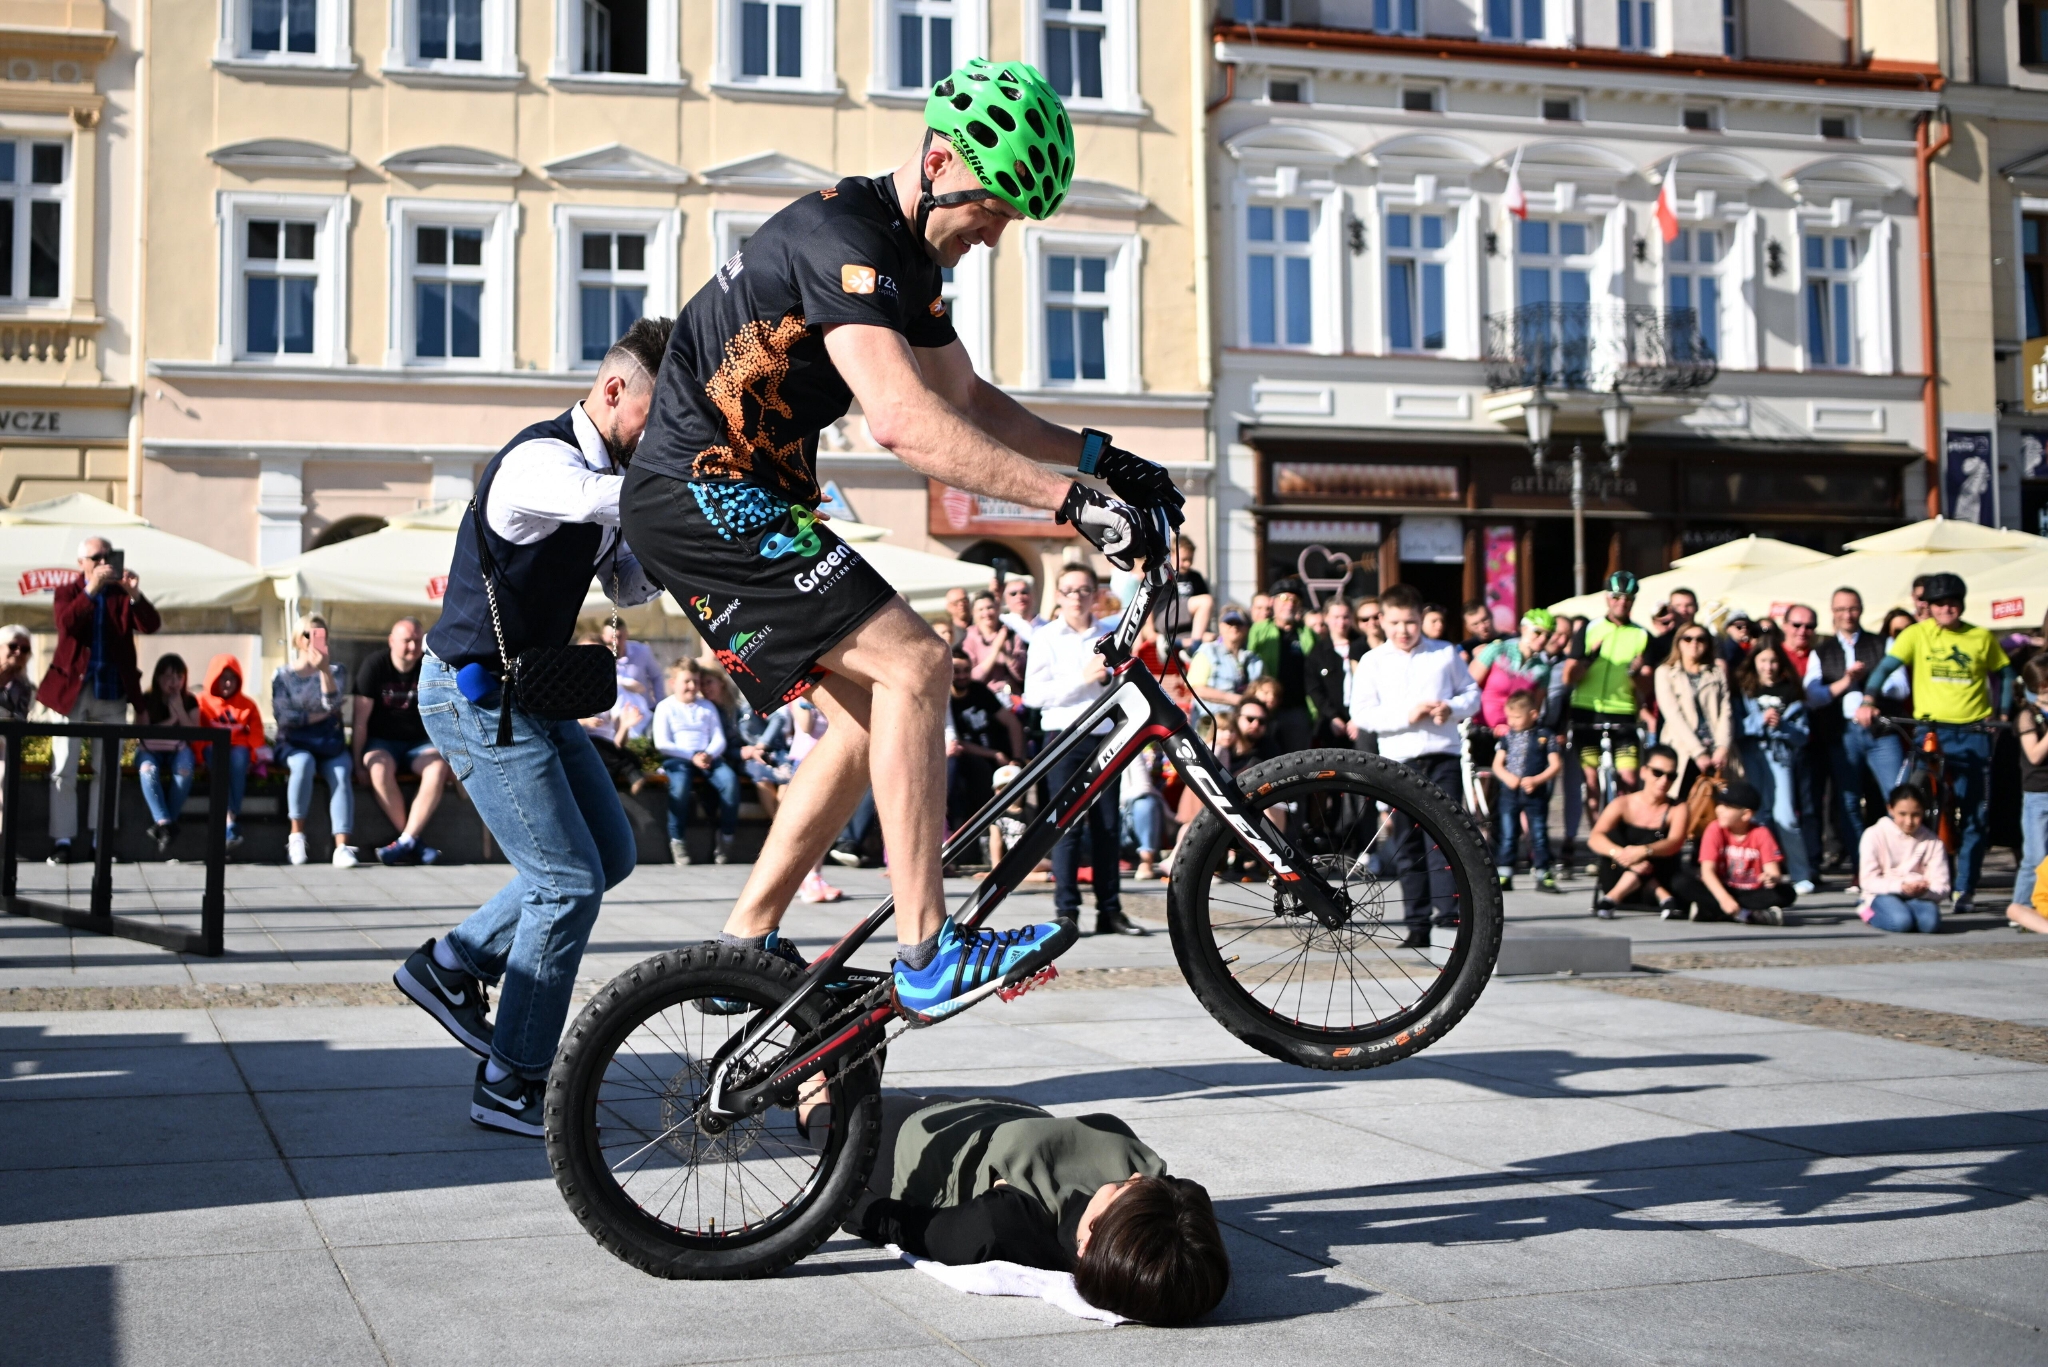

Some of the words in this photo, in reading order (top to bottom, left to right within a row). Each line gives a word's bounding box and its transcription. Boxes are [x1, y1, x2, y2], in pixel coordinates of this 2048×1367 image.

[953, 128, 993, 186] catlike
[817, 564, 850, 595] EASTERN
[1125, 578, 1153, 647] CLEAN
[737, 624, 773, 660] ARPACKIE
[1186, 765, 1294, 874] CLEAN
[847, 974, 880, 983] CLEAN
